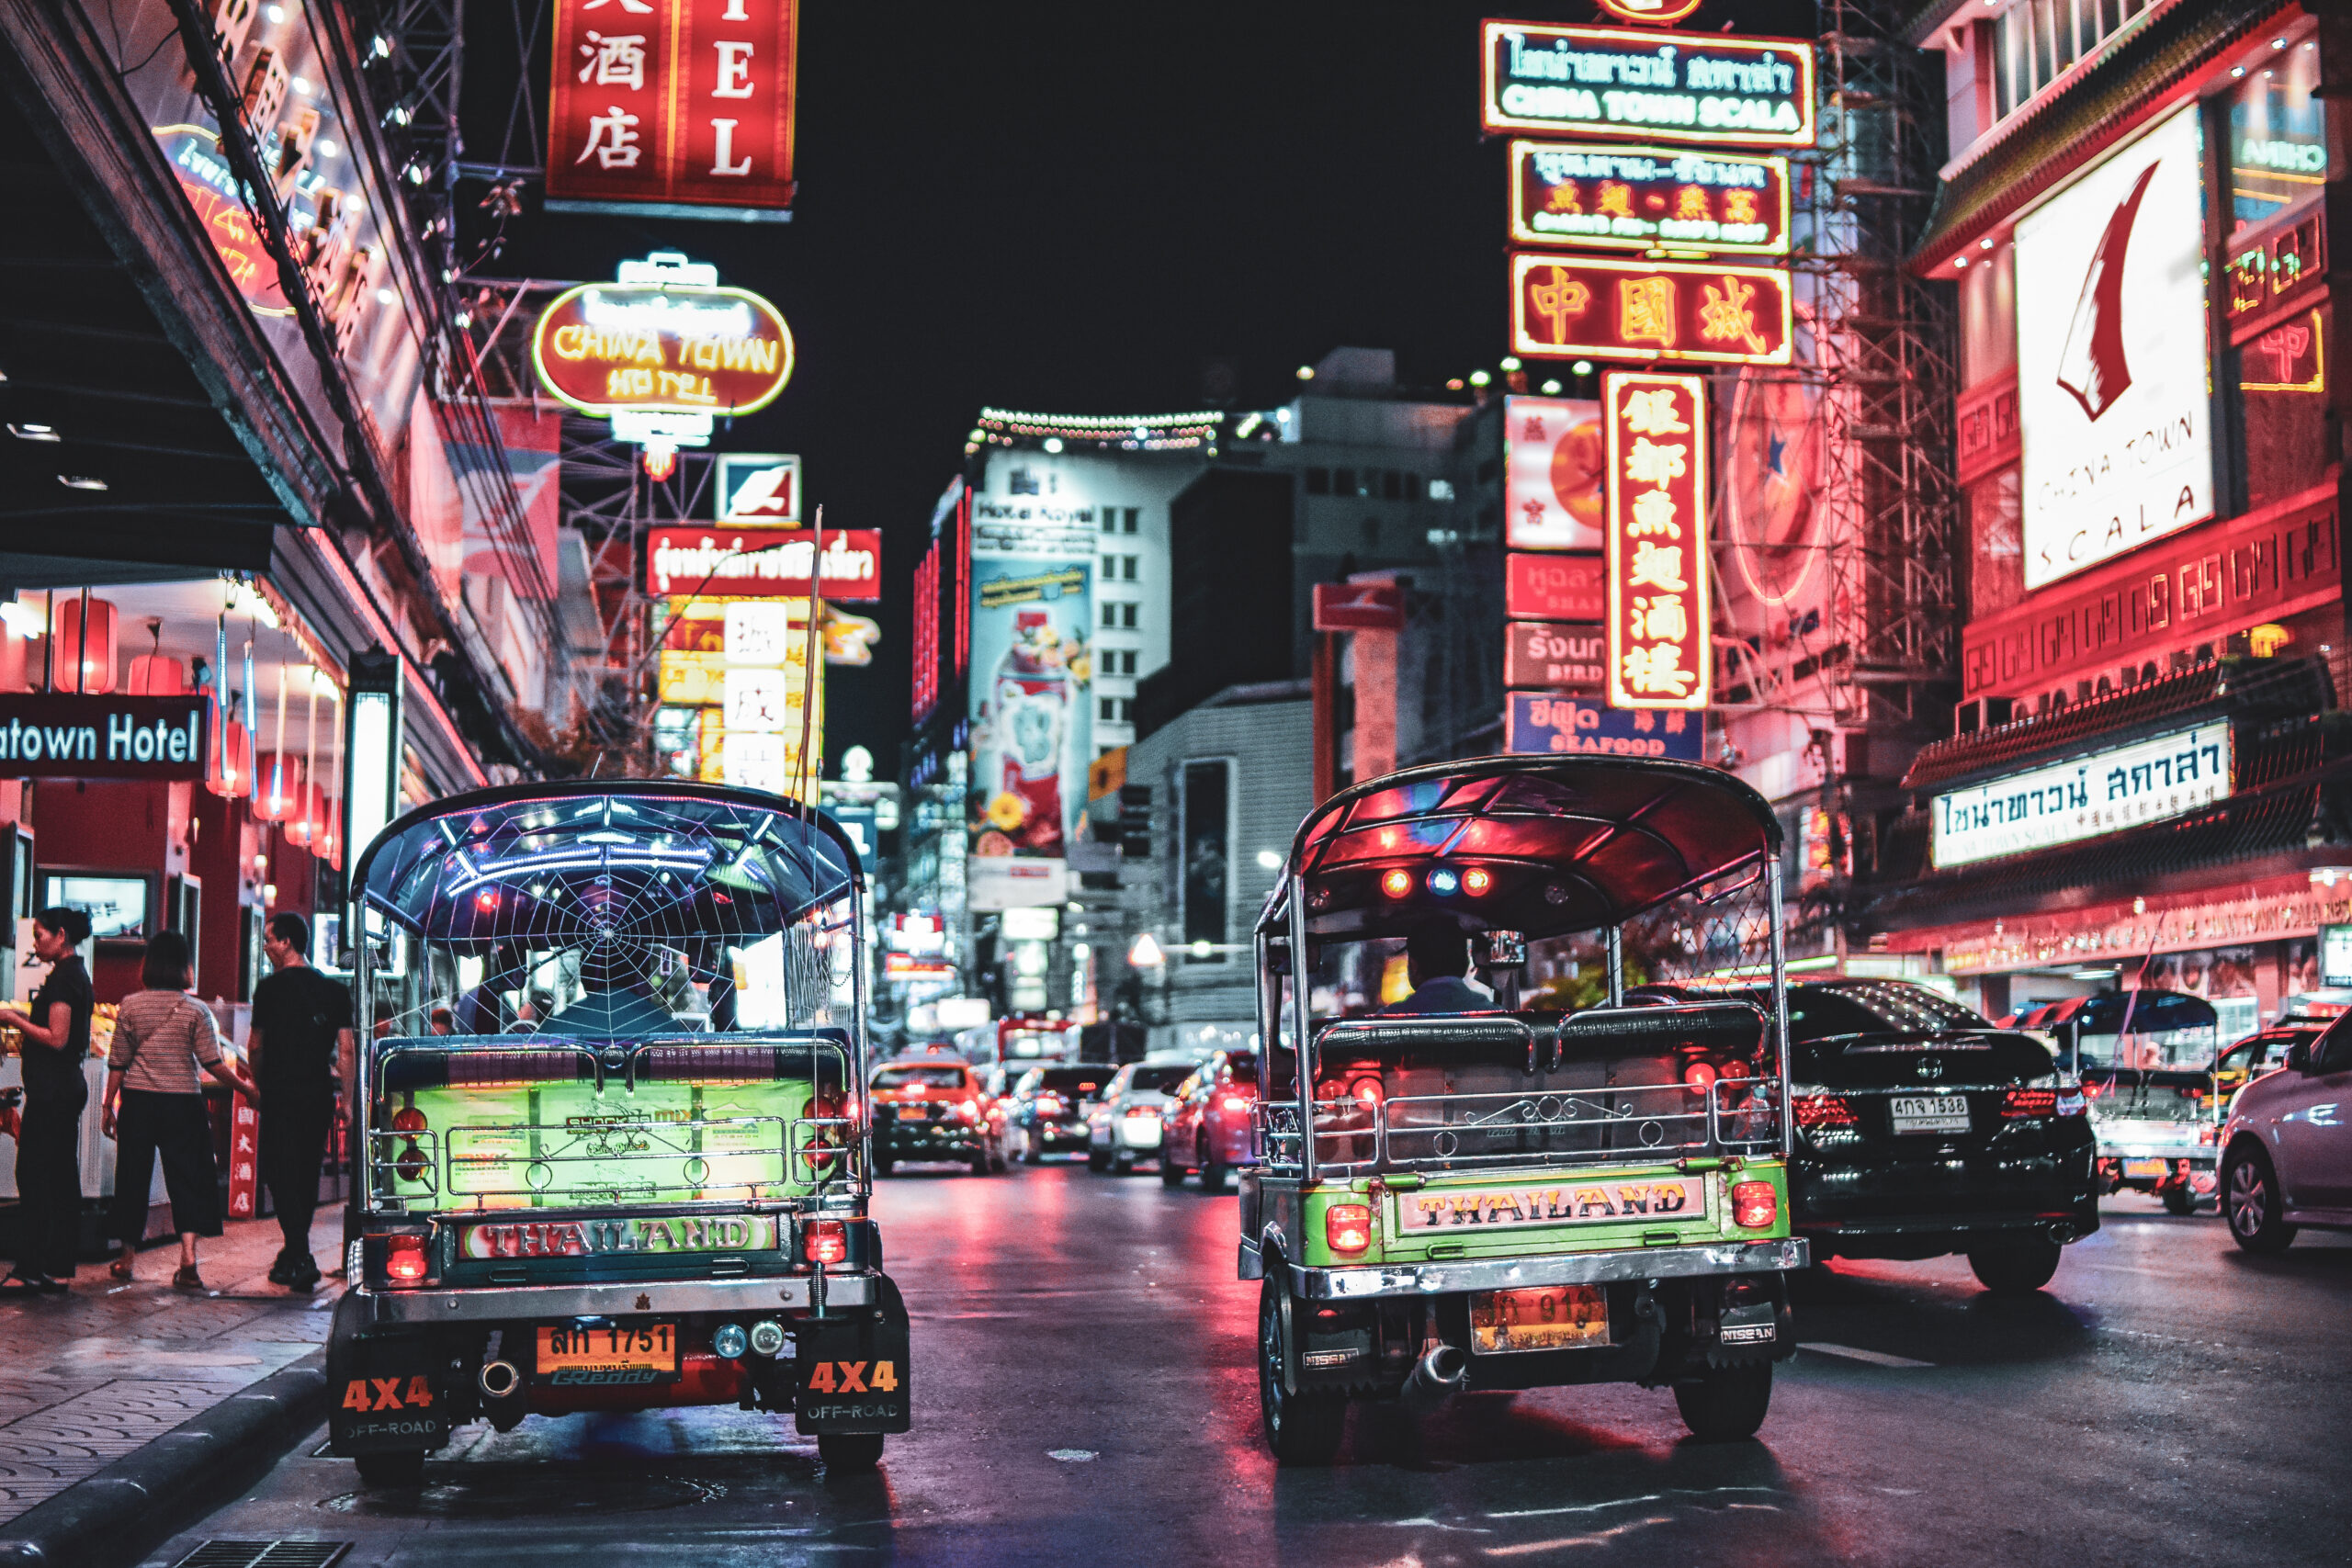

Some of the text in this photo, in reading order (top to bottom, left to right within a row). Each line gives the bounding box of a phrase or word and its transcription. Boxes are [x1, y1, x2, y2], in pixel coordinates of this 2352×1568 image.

[574, 0, 653, 170] 酒店
[1501, 84, 1801, 130] CHINA TOWN SCALA
[1532, 265, 1767, 354] 中國城
[554, 324, 777, 373] CHINA TOWN
[608, 368, 718, 404] HOTEL
[2126, 411, 2192, 468] TOWN
[2041, 485, 2194, 575] SCALA
[1547, 664, 1604, 682] BIRD
[107, 710, 198, 762] Hotel
[1550, 734, 1666, 756] SEAFOOD
[1419, 1184, 1686, 1226] THAILAND
[487, 1217, 752, 1256] THAILAND
[606, 1325, 668, 1354] 1751
[1723, 1327, 1773, 1341] NISSAN
[342, 1375, 434, 1412] 4X4
[808, 1360, 899, 1393] 4X4
[345, 1420, 436, 1438] OFF-ROAD
[808, 1404, 899, 1419] OFF-ROAD
